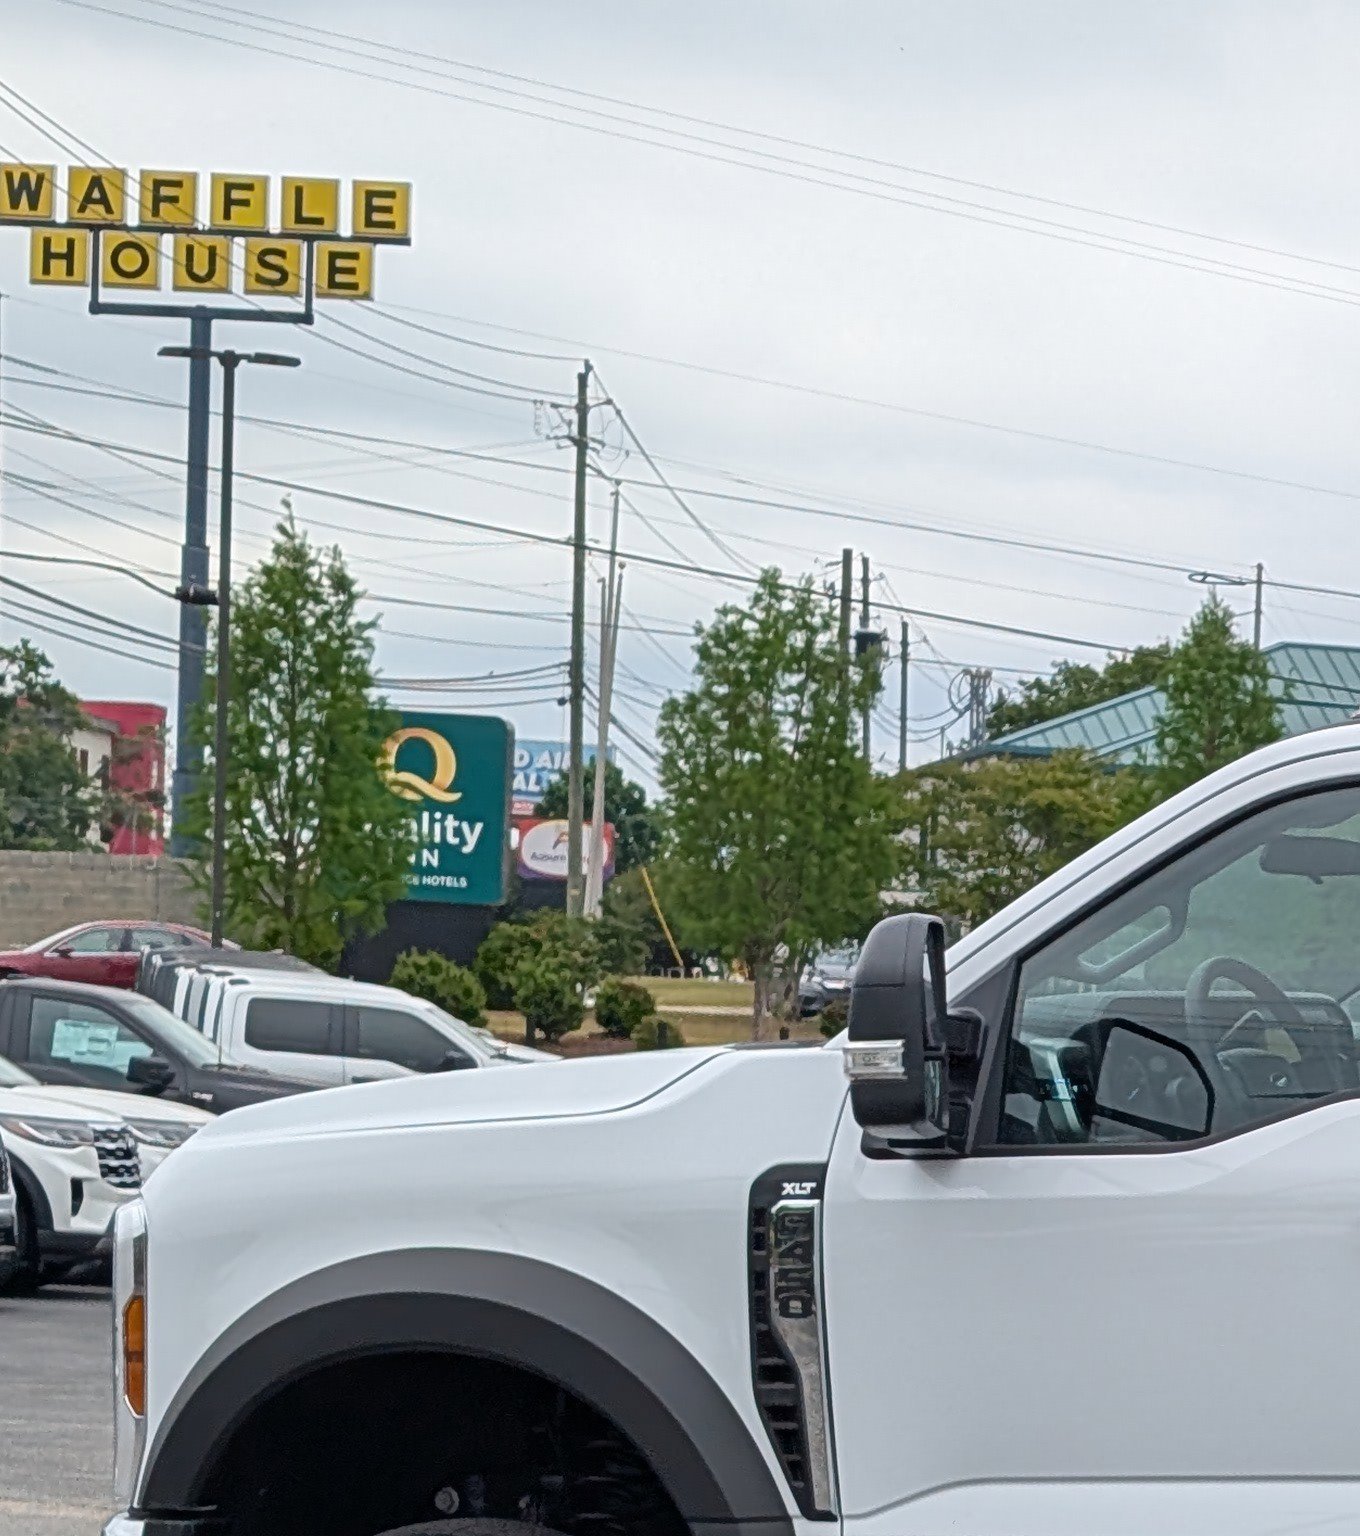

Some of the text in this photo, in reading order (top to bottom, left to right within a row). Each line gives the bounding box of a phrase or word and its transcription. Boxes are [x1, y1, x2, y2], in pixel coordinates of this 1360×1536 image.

[5, 171, 397, 230] WAFFLE
[41, 236, 361, 290] HOUSE
[422, 875, 468, 888] HOTELS
[781, 1182, 818, 1195] XLT
